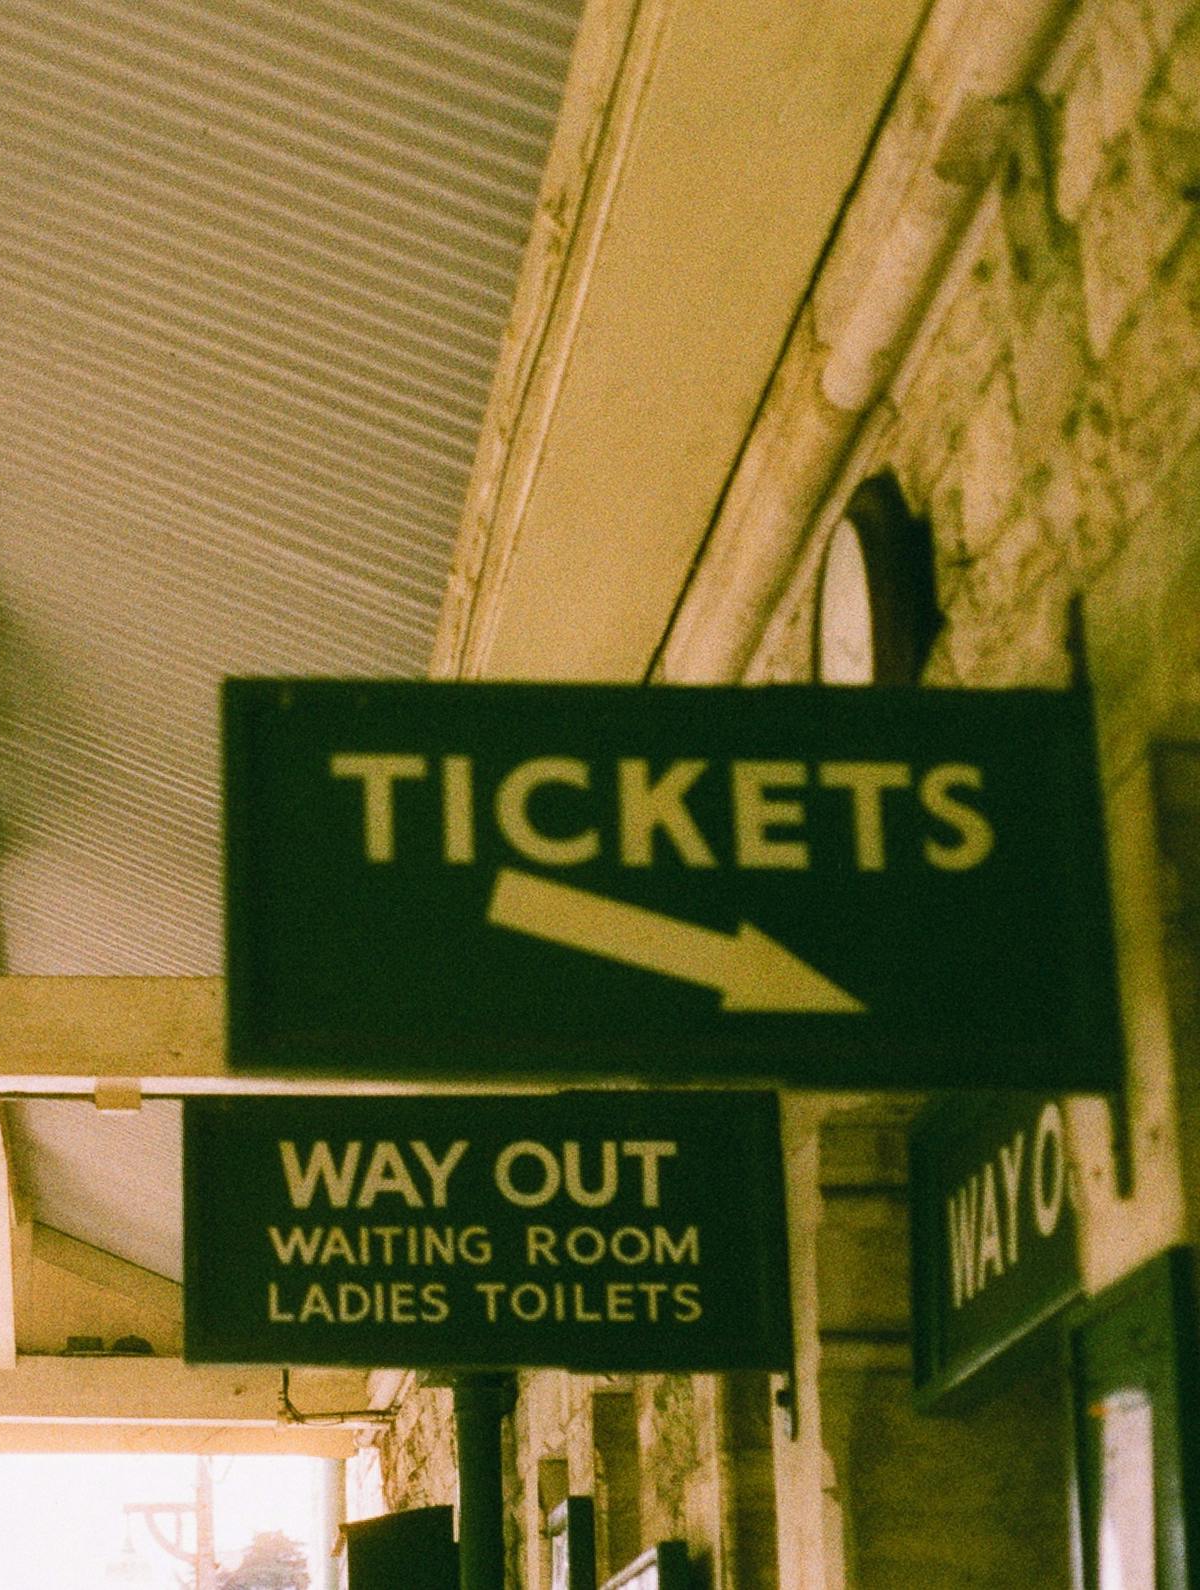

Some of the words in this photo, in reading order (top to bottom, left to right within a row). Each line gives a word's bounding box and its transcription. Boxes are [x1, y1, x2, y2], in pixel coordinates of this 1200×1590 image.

[330, 753, 993, 870] TICKETS
[279, 1140, 469, 1208] WAY
[494, 1140, 677, 1208] OUT
[267, 1225, 493, 1266] WAITING
[525, 1225, 700, 1266] ROOM
[948, 1131, 1026, 1309] WAY
[267, 1281, 450, 1324] LADIES
[474, 1281, 704, 1324] TOILETS
